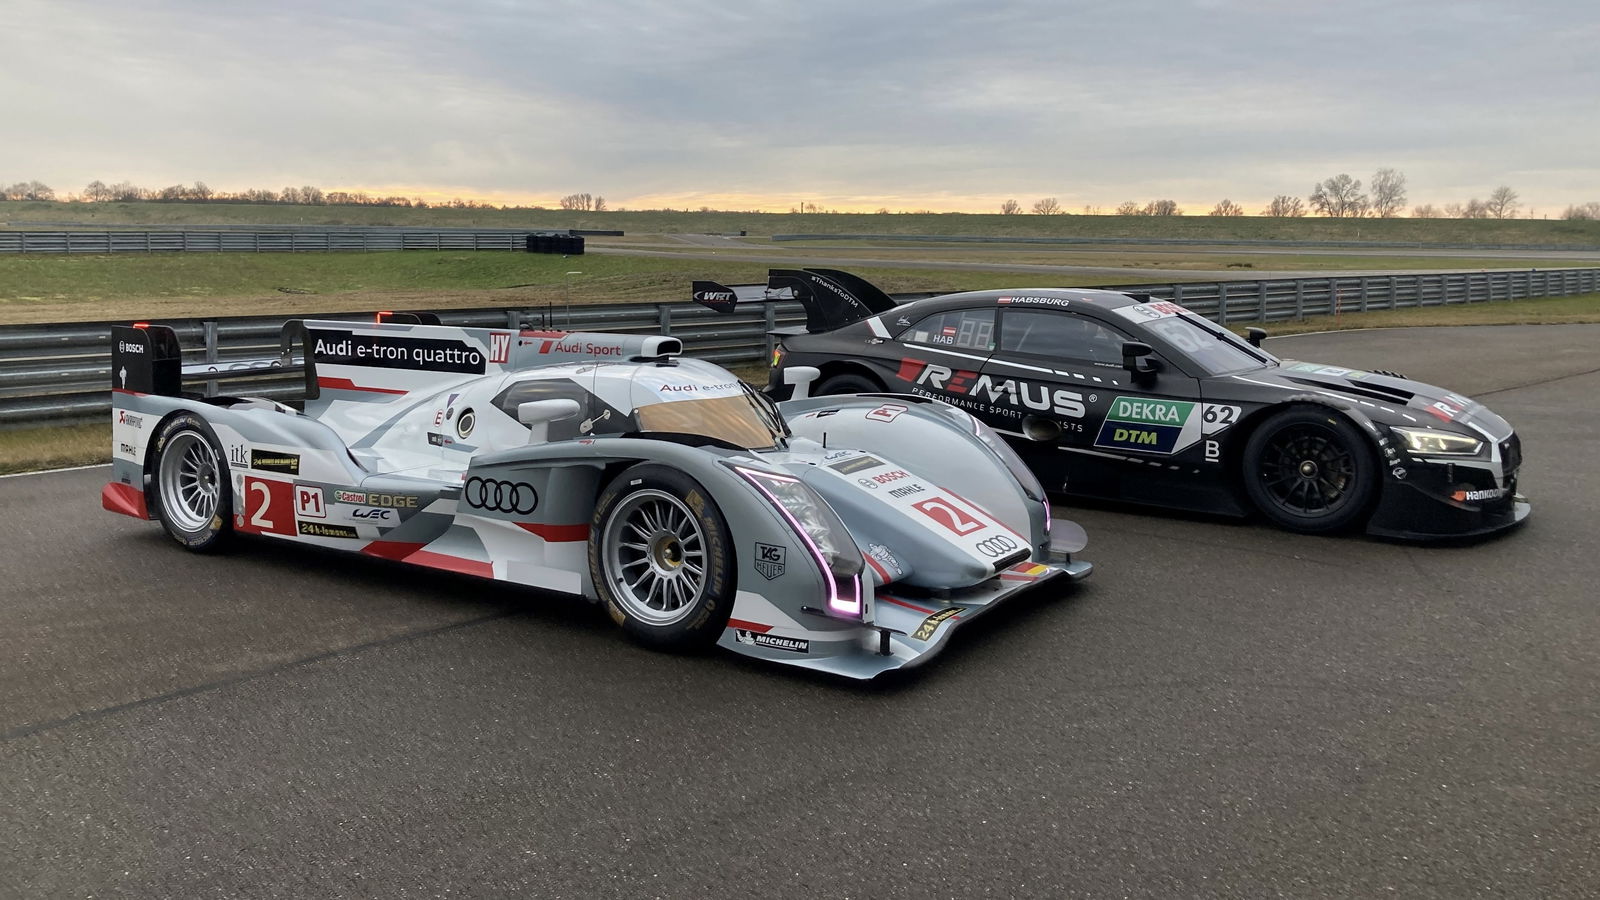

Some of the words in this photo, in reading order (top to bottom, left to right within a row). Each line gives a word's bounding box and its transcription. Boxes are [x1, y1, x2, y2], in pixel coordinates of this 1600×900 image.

[703, 291, 733, 301] WRT
[1010, 296, 1070, 307] HABSBURG
[125, 341, 144, 354] BOSCH
[489, 333, 511, 362] HY
[933, 334, 954, 345] HAB
[314, 338, 352, 356] Audi
[357, 343, 408, 360] e-tron
[413, 346, 480, 365] quattro
[554, 341, 582, 354] Audi
[586, 342, 622, 357] Sport
[659, 383, 698, 392] Audi
[702, 382, 735, 391] e-tron
[916, 363, 1086, 419] REMUS
[911, 386, 985, 412] PERFORMANCE
[989, 405, 1022, 420] SPORT
[435, 411, 443, 425] E
[1118, 401, 1180, 423] DEKRA
[1203, 405, 1235, 425] 62
[1113, 428, 1158, 445] DTM
[231, 444, 248, 464] itk
[1205, 440, 1220, 460] B
[872, 470, 910, 484] BOSCH
[341, 491, 366, 503] Castrol
[888, 483, 925, 499] MAHLE
[250, 481, 274, 529] 2
[300, 491, 320, 513] P1
[368, 493, 419, 508] EDGE
[352, 508, 391, 520] WEC
[922, 501, 979, 533] 2
[760, 545, 781, 561] TAG
[756, 561, 783, 578] HEUER
[756, 635, 808, 650] MICHELIN
